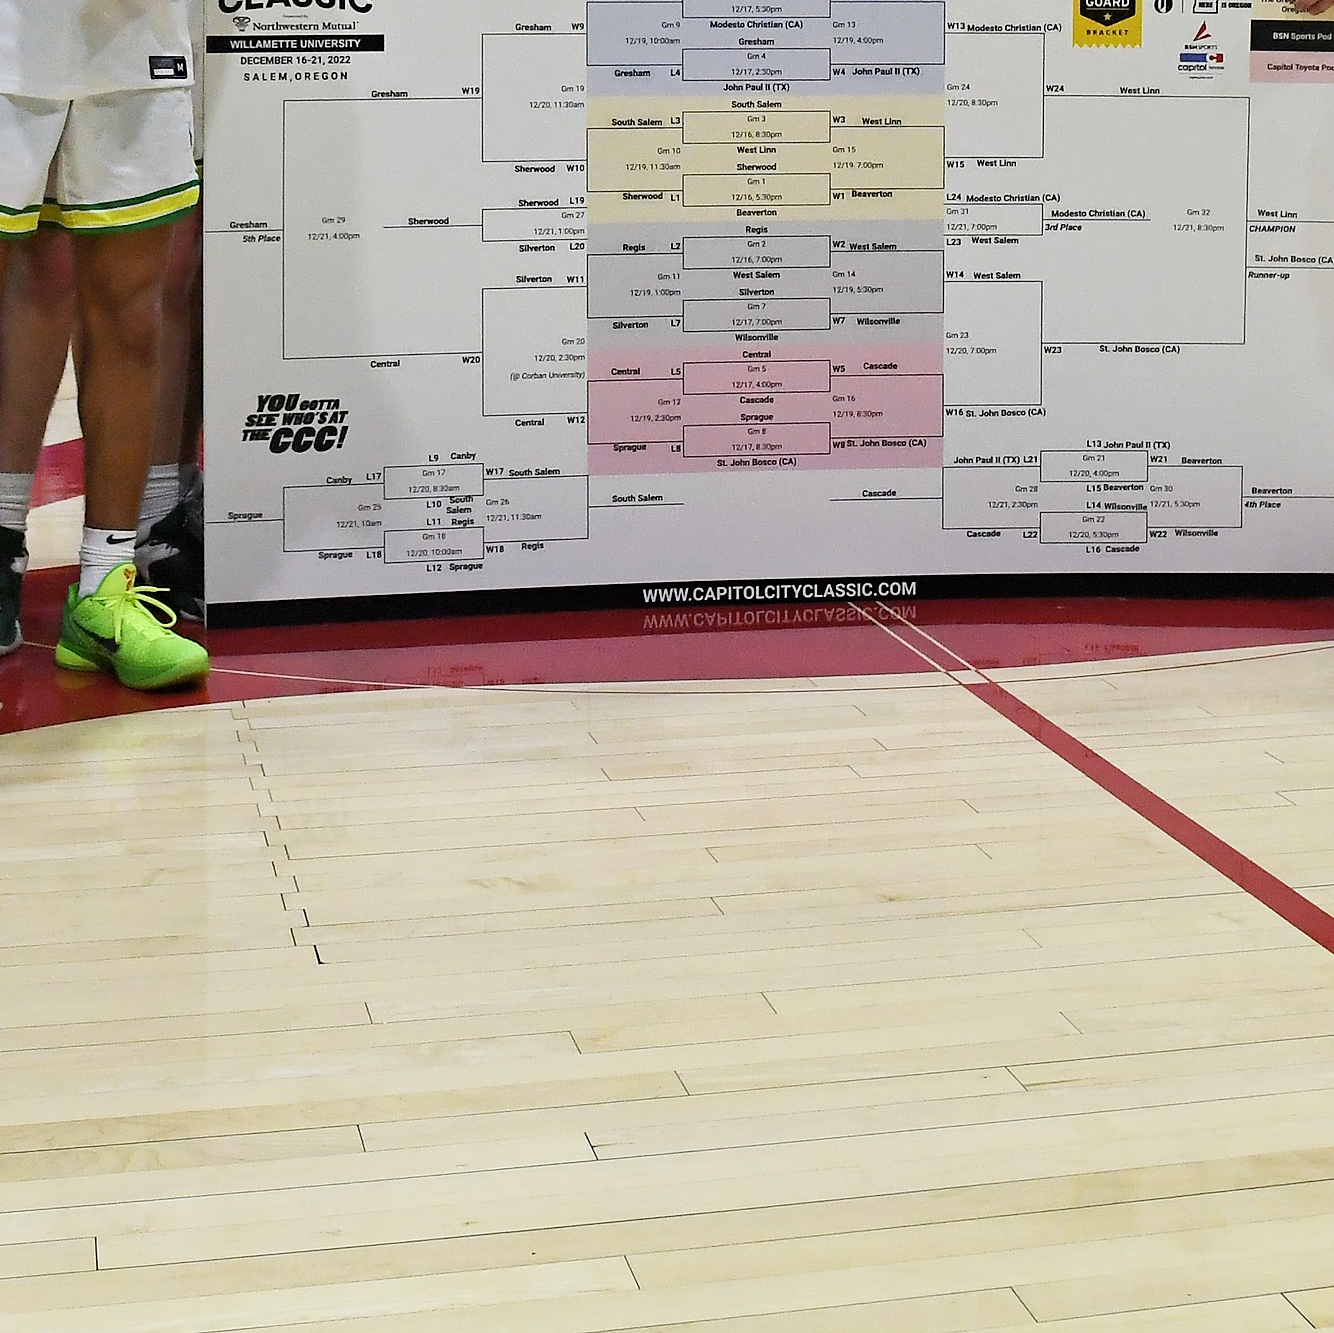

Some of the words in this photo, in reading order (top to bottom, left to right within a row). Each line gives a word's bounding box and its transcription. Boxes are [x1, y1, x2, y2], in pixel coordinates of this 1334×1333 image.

[252, 21, 319, 31] Northwestern
[321, 21, 357, 31] Mutual
[515, 23, 551, 31] Gresham
[744, 20, 782, 28] Christian
[785, 20, 803, 29] (CA)
[1044, 23, 1062, 32] (CA)
[1272, 32, 1290, 40] BSN
[1290, 32, 1316, 41] Sports
[1317, 32, 1333, 40] Pod
[229, 39, 298, 49] WILLAMETTE
[300, 38, 362, 49] UNIVERSITY
[240, 56, 293, 65] DECEMBER
[296, 55, 326, 66] 16-21,
[327, 55, 351, 64] 2022
[1177, 63, 1207, 72] capitol
[1267, 63, 1293, 72] Capitol
[1295, 64, 1320, 72] Toyota
[742, 83, 763, 91] Paul
[773, 83, 790, 92] (TX)
[1124, 210, 1145, 218] (CA)
[1258, 209, 1277, 217] West
[230, 221, 267, 229] Gresham
[1249, 225, 1296, 233] CHAMPION
[746, 226, 768, 234] Regis
[733, 271, 753, 279] West
[1248, 271, 1290, 280] Runner-up
[739, 288, 774, 296] Silverton
[735, 333, 778, 341] Wilsonville
[1162, 346, 1180, 354] (CA)
[370, 360, 400, 368] Central
[256, 393, 300, 412] YOU
[299, 399, 341, 411] GOTTA
[245, 414, 278, 427] SEE
[281, 411, 328, 426] WHO'S
[327, 410, 349, 424] AT
[741, 414, 773, 422] Sprague
[241, 429, 272, 442] THE
[268, 425, 349, 453] CCC!
[1103, 439, 1126, 449] John
[1153, 441, 1170, 450] (TX)
[779, 458, 796, 467] (CA)
[638, 494, 663, 502] Salem
[227, 512, 263, 522] Sprague
[643, 581, 917, 603] WWW.CAPITOLCITYCLASSIC.COM
